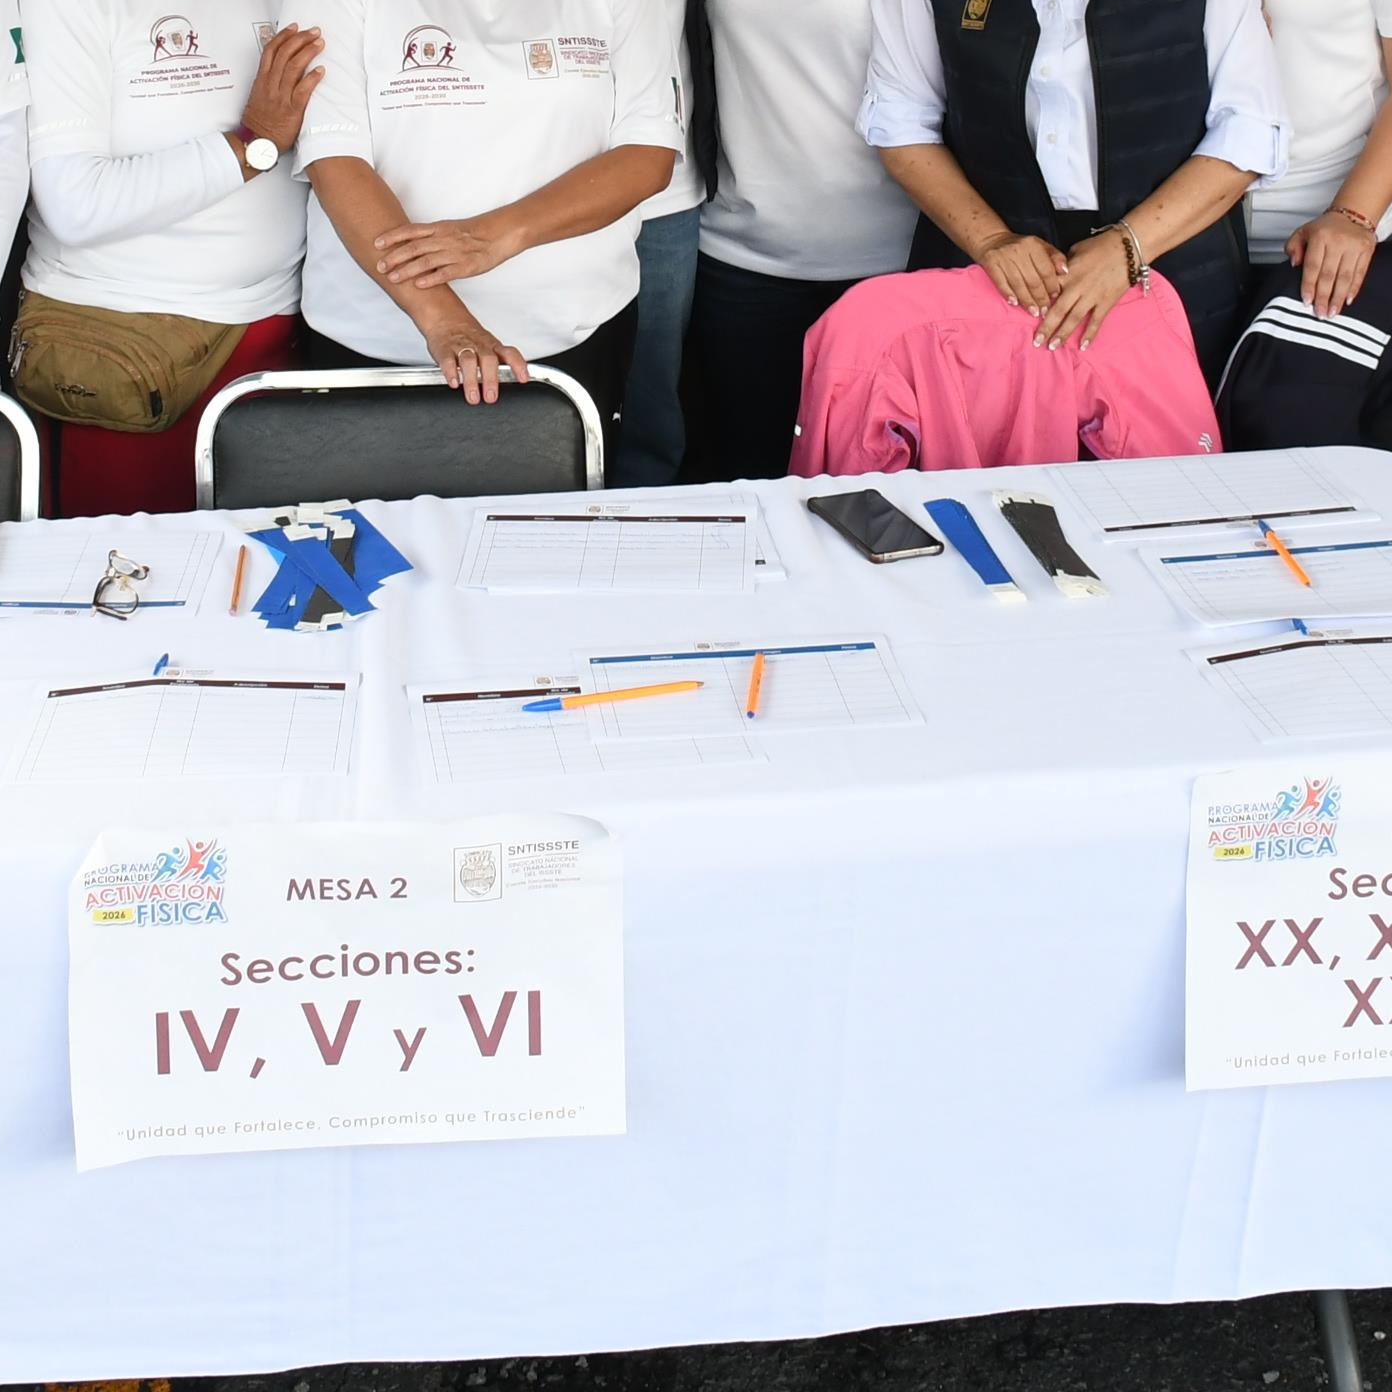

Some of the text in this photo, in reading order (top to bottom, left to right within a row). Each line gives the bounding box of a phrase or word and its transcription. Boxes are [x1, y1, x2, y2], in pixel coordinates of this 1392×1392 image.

[558, 37, 607, 48] SNTISSSTE
[1208, 815, 1256, 824] NACIONAL
[508, 840, 579, 856] SNTISSSTE
[84, 875, 136, 886] NACIONAL
[286, 876, 409, 902] MESA 2
[102, 911, 126, 920] 2026
[1234, 918, 1342, 971] XX,
[220, 943, 477, 987] Secciones:
[154, 989, 542, 1080] IV, V y VI
[1296, 1053, 1327, 1066] que
[195, 1125, 227, 1137] que
[328, 1111, 438, 1129] Compromiso
[445, 1110, 478, 1124] que
